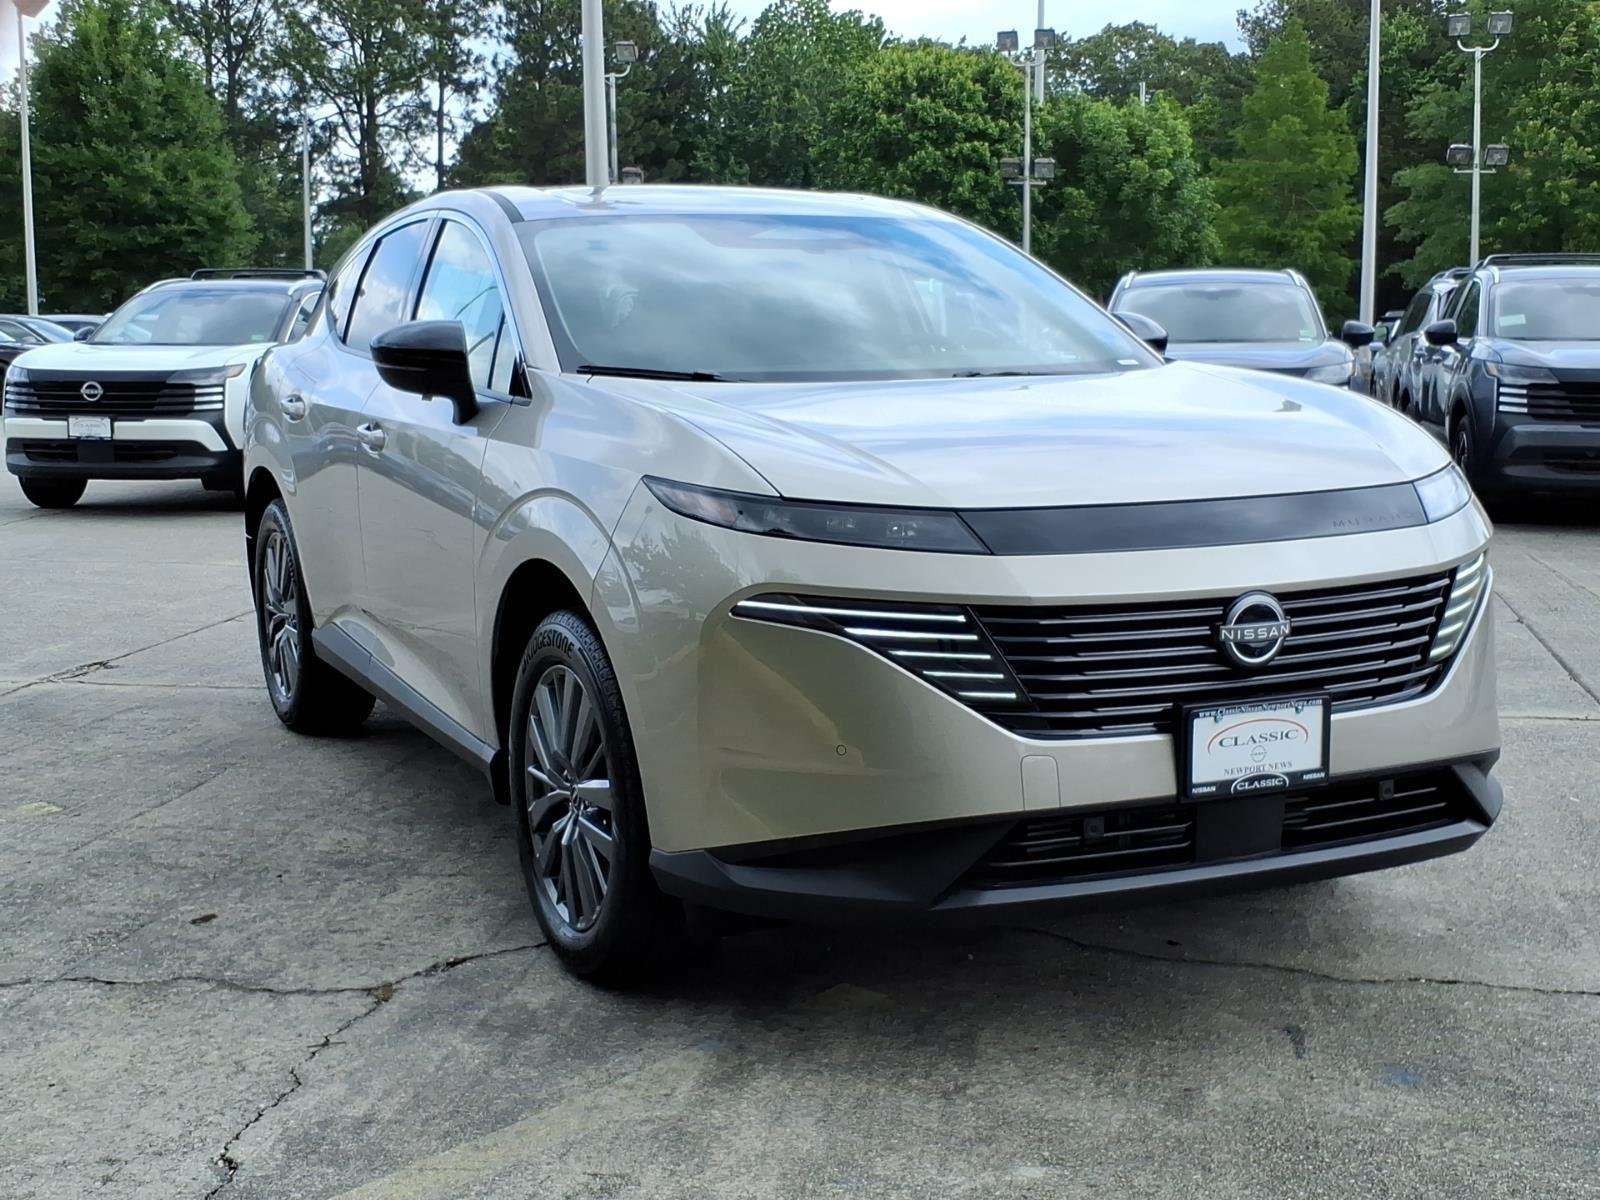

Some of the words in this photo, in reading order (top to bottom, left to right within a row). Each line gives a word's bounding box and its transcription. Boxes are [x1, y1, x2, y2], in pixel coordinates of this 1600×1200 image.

[1221, 624, 1290, 640] NISSAN
[1219, 730, 1298, 748] CLASSIC
[1224, 763, 1266, 775] NEWPORT
[1268, 761, 1293, 771] NEWS
[1303, 772, 1325, 780] NISSAN
[1192, 785, 1216, 793] NISSAN
[1236, 778, 1284, 790] CLASSIC
